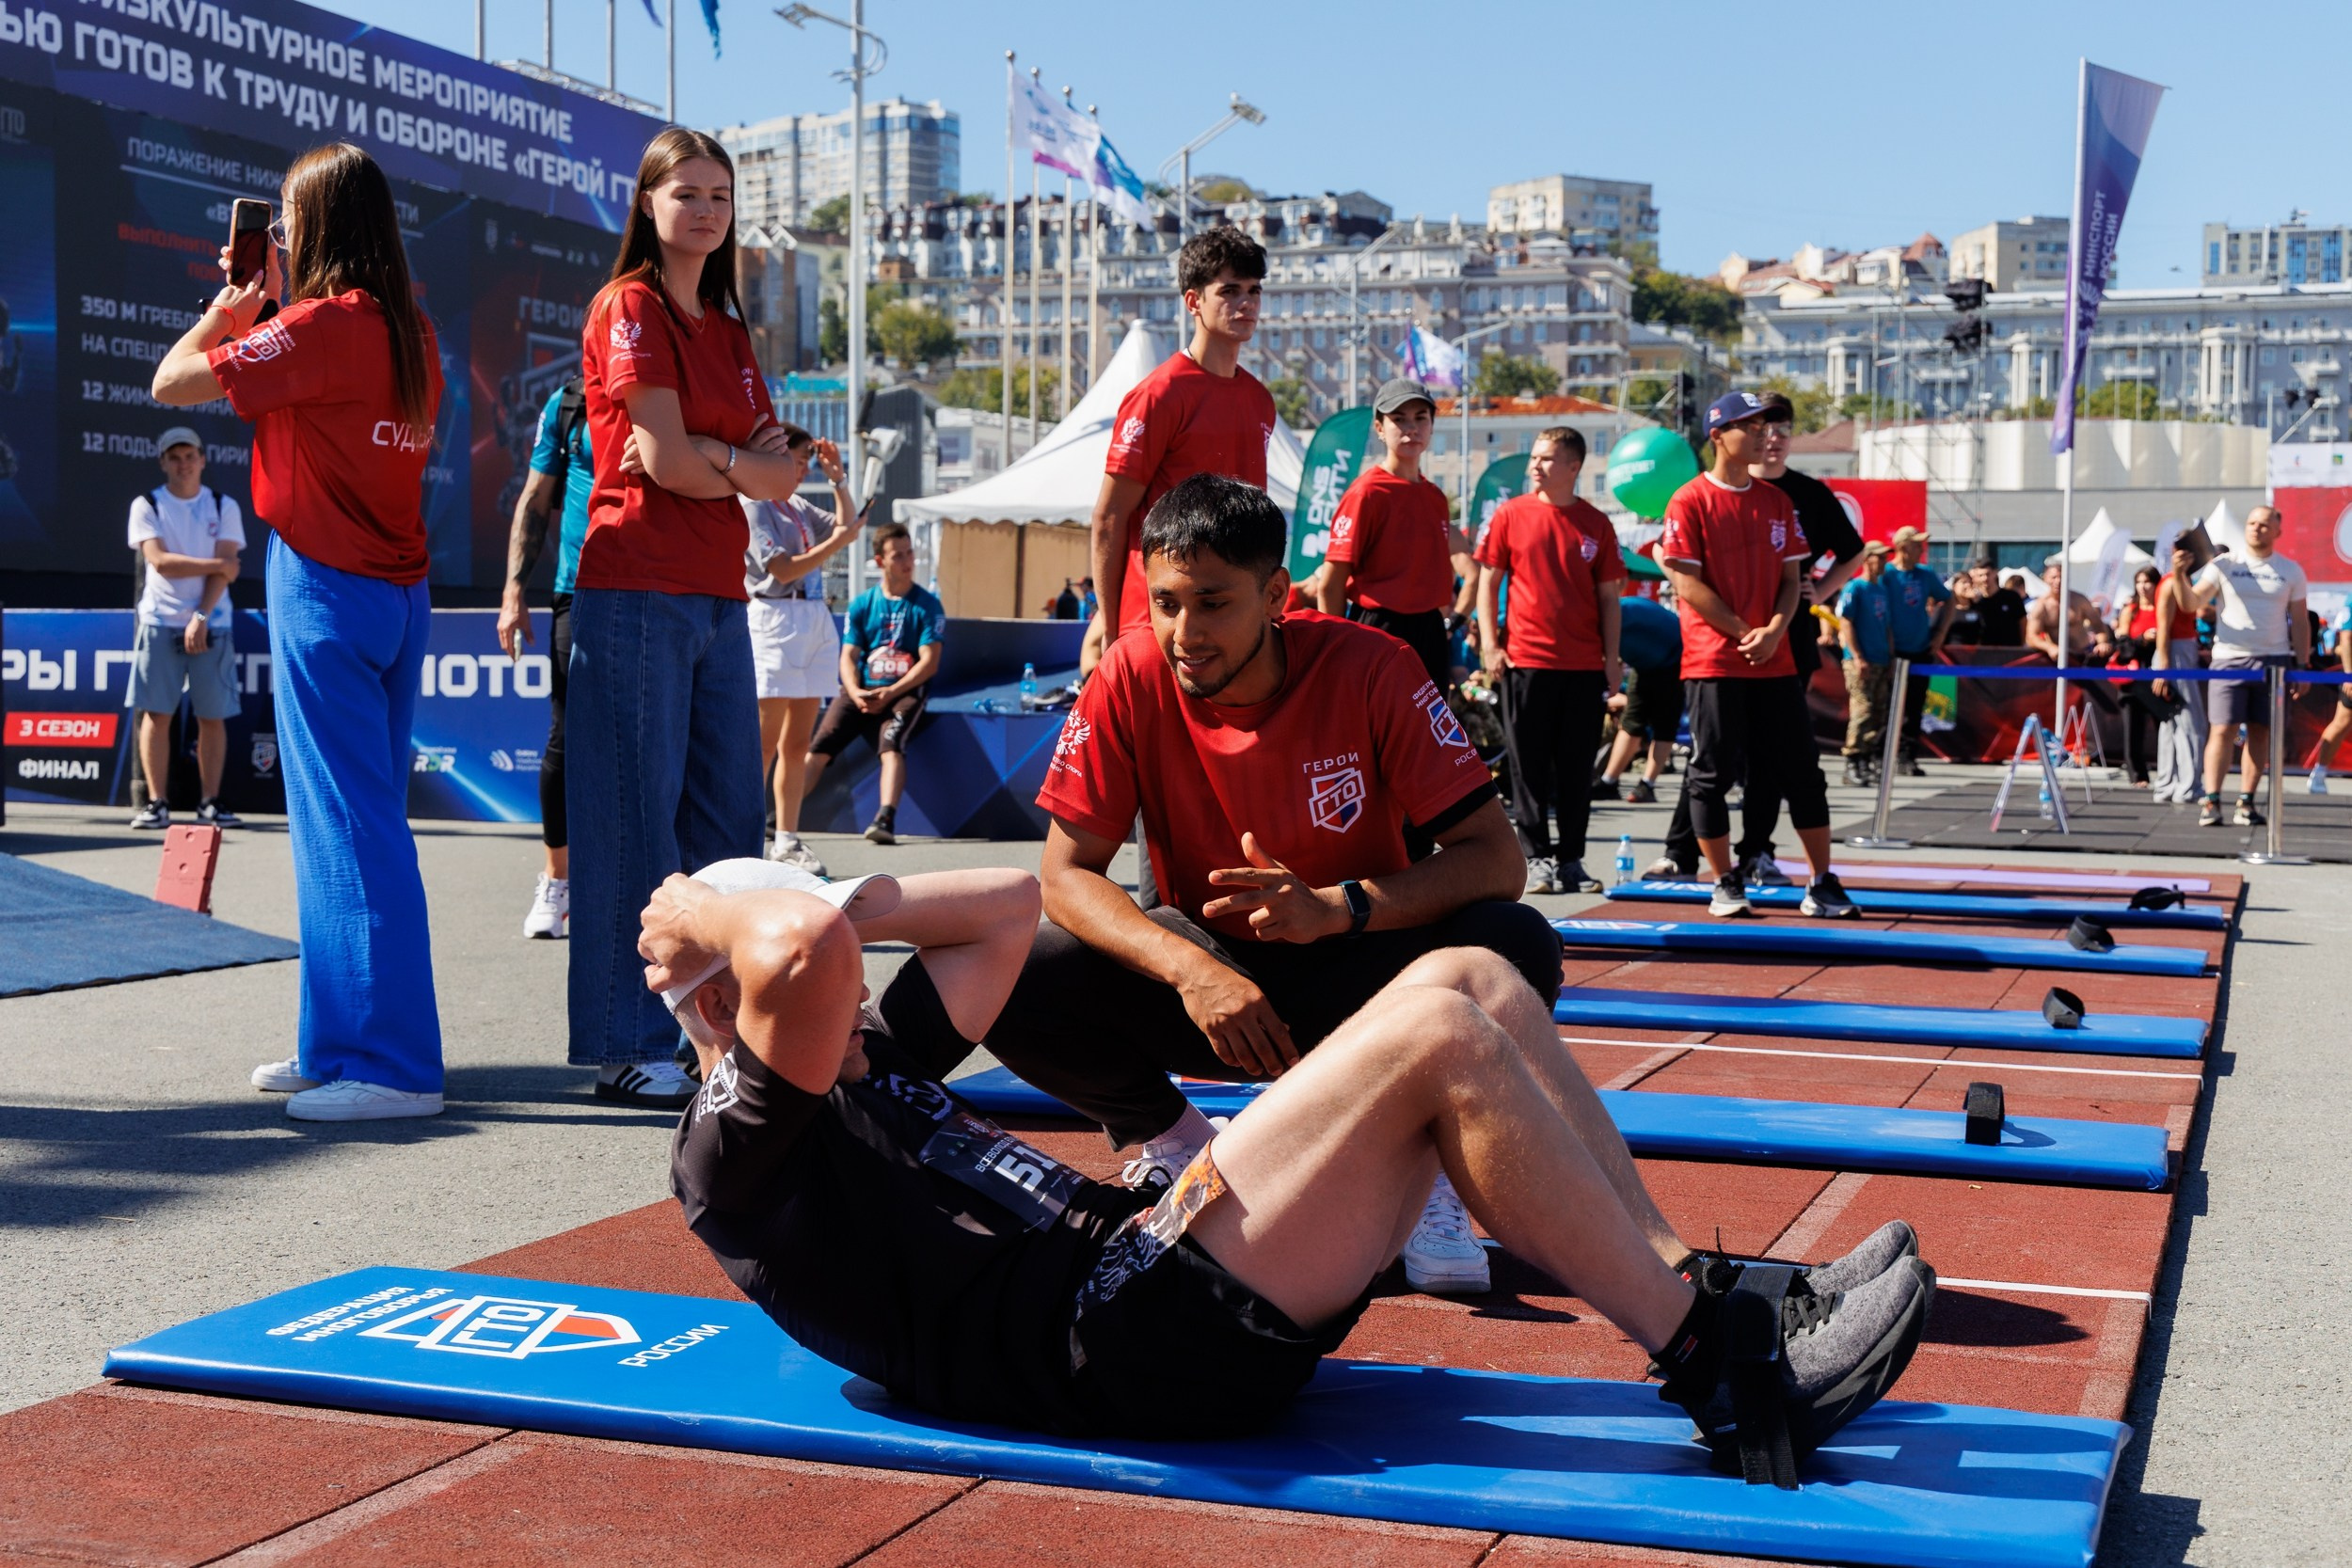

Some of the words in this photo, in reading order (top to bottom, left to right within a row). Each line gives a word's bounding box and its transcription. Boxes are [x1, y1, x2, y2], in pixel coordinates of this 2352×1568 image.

[78, 0, 366, 84] ЗКУЛЬТУРНОЕ
[373, 55, 573, 143] МЕРОПРИЯТИЕ
[74, 22, 194, 89] ГОТОВ
[203, 59, 228, 100] К
[233, 68, 340, 131] ТРУДУ
[346, 99, 368, 136] И
[376, 106, 508, 171] ОБОРОНЕ
[514, 148, 605, 198] «ГЕРОЙ
[611, 172, 637, 206] ГТ
[127, 137, 242, 182] ПОРАЖЕНИЕ
[2084, 190, 2106, 277] МИНСПОРТ
[2099, 213, 2119, 279] РОССИИ
[81, 295, 118, 319] 350
[120, 302, 137, 322] М
[141, 305, 199, 330] ГРЕБЛ
[81, 333, 107, 355] НА
[82, 380, 103, 400] 12
[82, 432, 103, 452] 12
[19, 720, 32, 737] 3
[36, 719, 100, 738] СЕЗОН
[18, 758, 99, 780] ФИНАЛ
[1303, 752, 1359, 774] ГЕРОИ
[1317, 780, 1358, 818] ГТО
[994, 1144, 1059, 1193] 51
[265, 1286, 415, 1336] ФЕДЕРАЦИЯ
[292, 1288, 454, 1342] МНОГОБОРЬЯ
[450, 1305, 538, 1349] ГТО
[617, 1323, 730, 1368] РОССИИ
